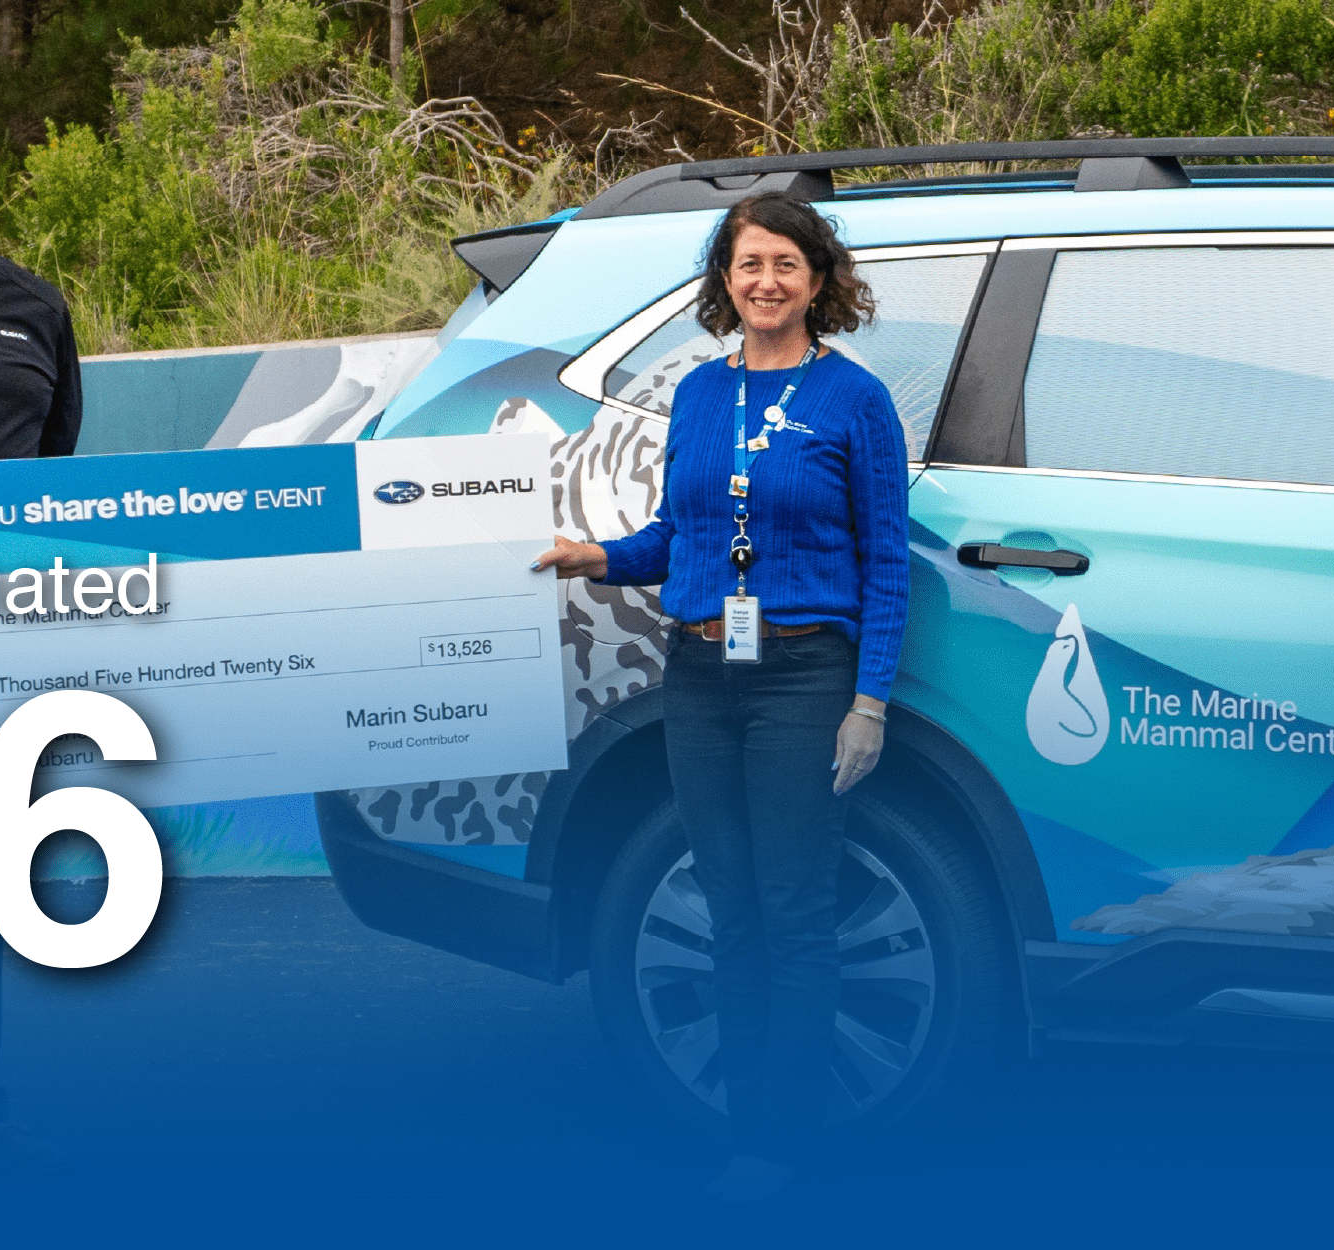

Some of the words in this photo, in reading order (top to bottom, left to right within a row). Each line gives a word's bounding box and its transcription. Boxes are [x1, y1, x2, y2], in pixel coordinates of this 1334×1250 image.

[431, 477, 535, 498] SUBARU
[24, 494, 117, 524] share
[121, 490, 176, 518] the
[255, 486, 326, 510] EVENT
[428, 639, 493, 661] $13,526
[95, 669, 133, 686] Five
[138, 661, 216, 683] Hundred
[220, 656, 283, 679] Twenty
[288, 653, 316, 670] Six
[346, 707, 407, 729] Marin
[413, 701, 489, 723] Subaru
[1122, 686, 1181, 715] The
[1192, 689, 1298, 722] Marine
[368, 738, 403, 751] Proud
[406, 732, 470, 748] Contributor
[1121, 717, 1255, 751] Mammal
[39, 750, 94, 767] ubaru
